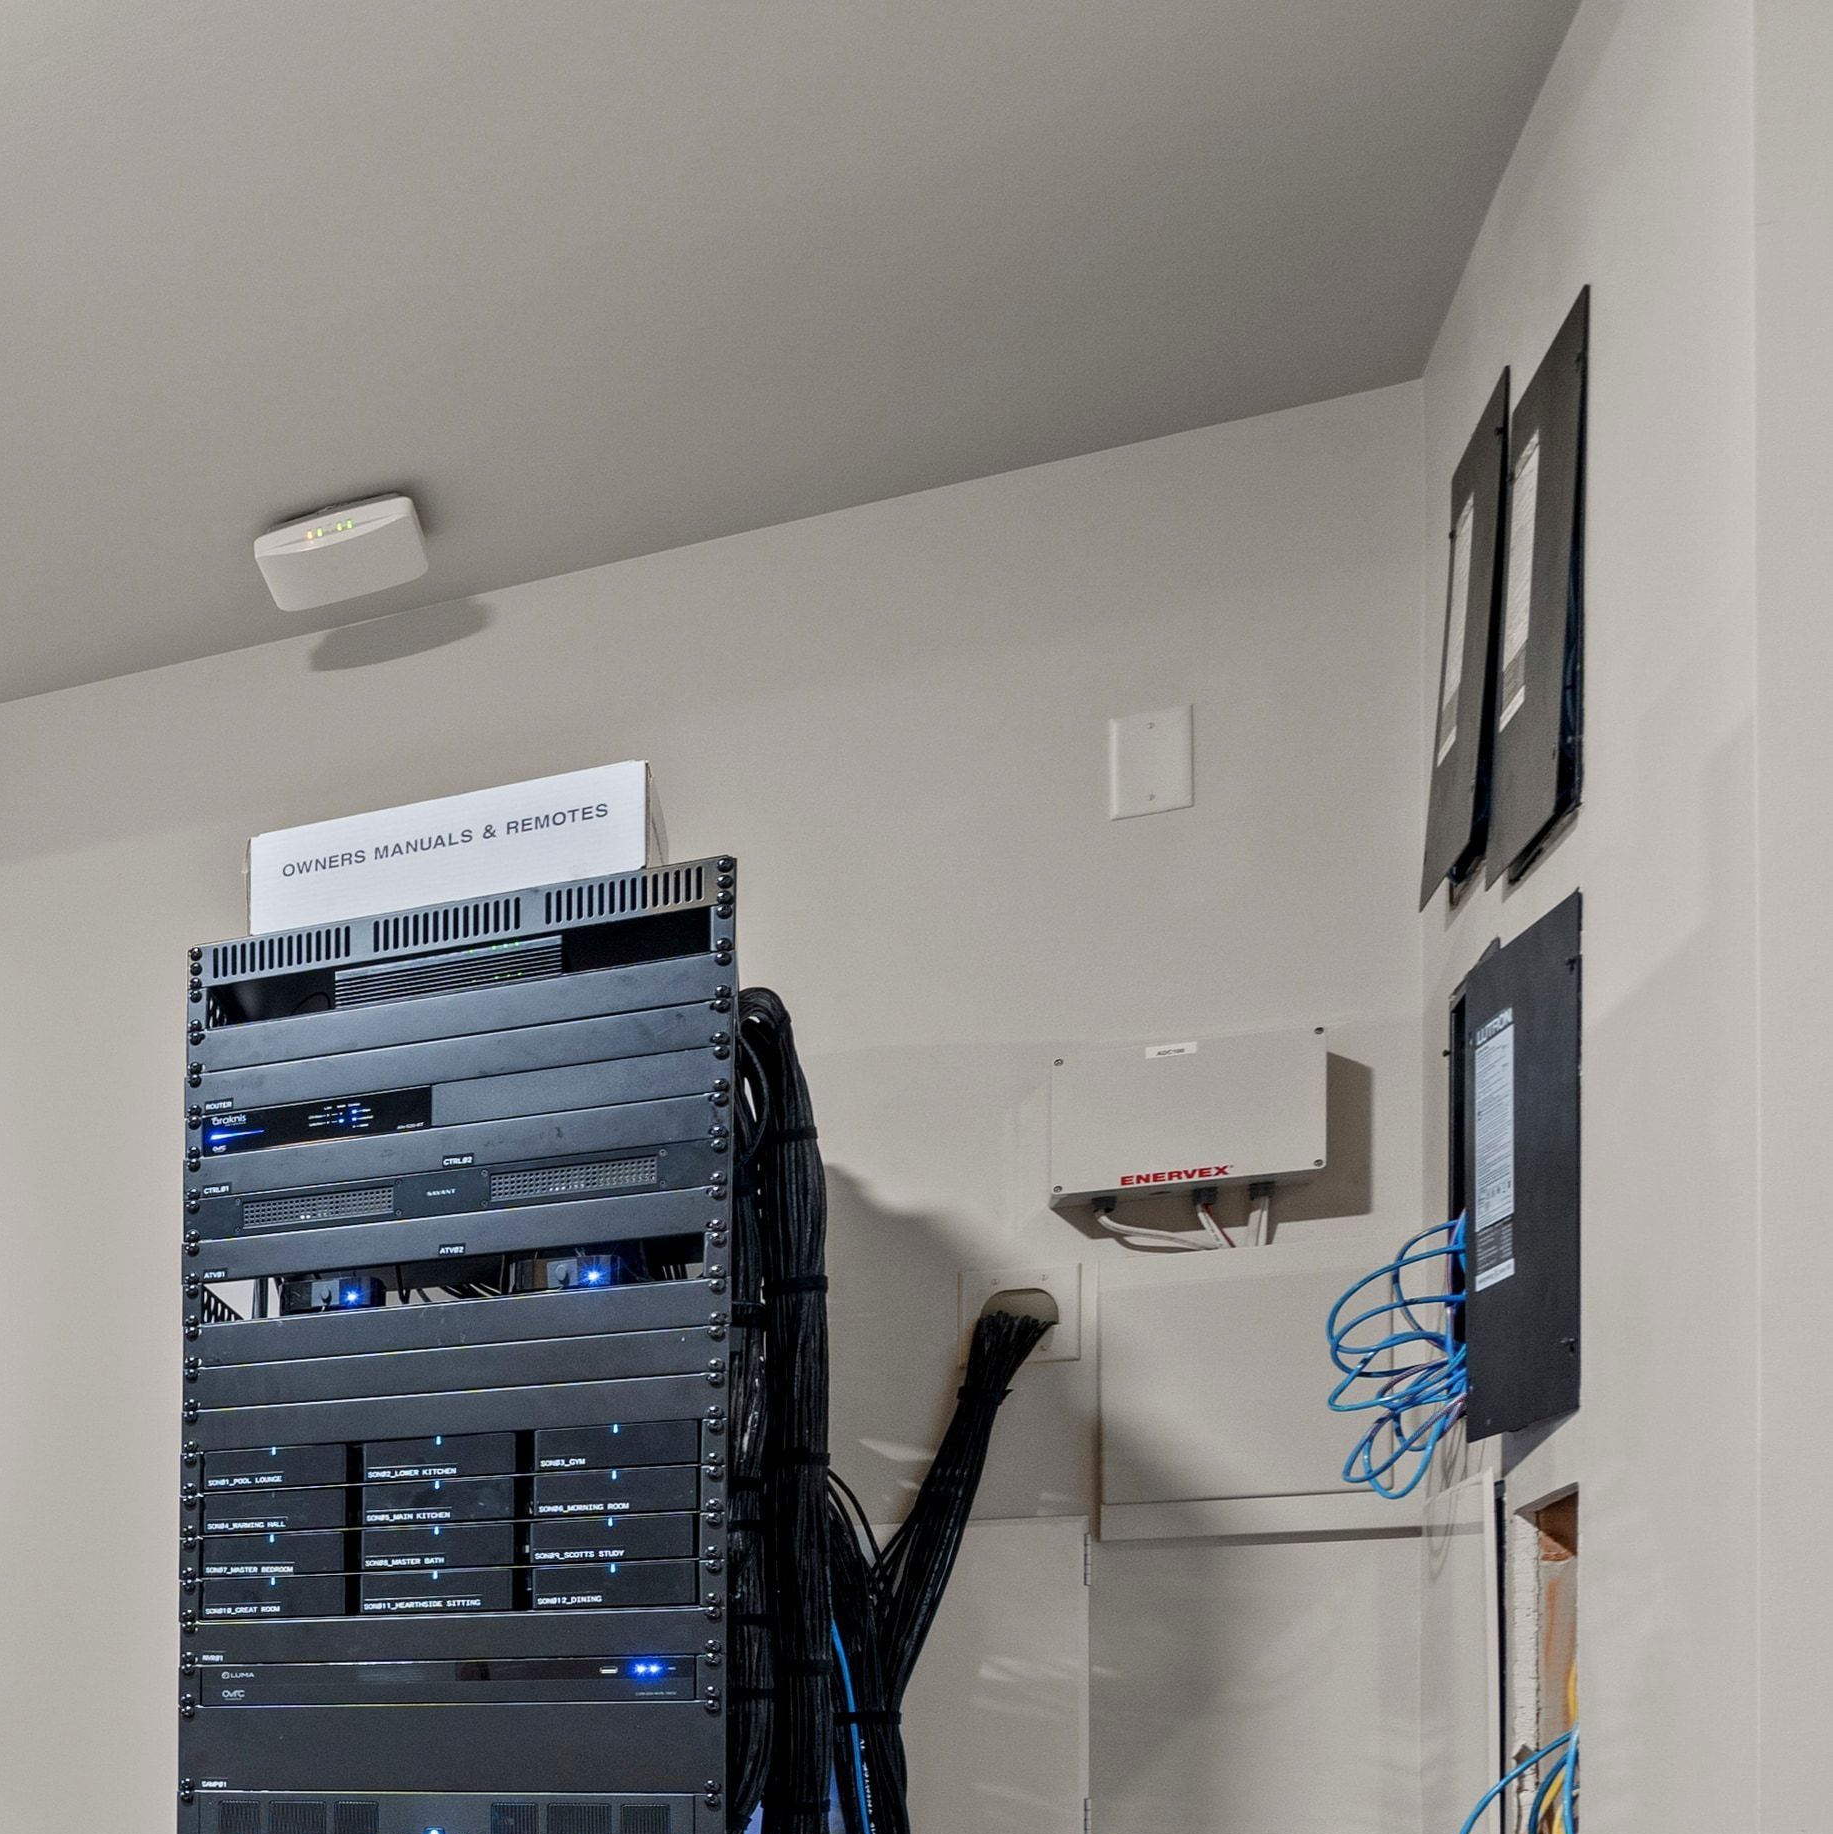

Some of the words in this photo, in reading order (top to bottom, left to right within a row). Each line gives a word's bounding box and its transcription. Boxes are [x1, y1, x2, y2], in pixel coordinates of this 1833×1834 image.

[282, 849, 366, 878] OWNERS
[373, 828, 473, 862] MANUALS
[482, 824, 497, 840] &
[506, 802, 609, 836] REMOTES
[205, 1101, 233, 1111] ROUTER
[1120, 1165, 1230, 1186] ENERVEX
[439, 1246, 464, 1255] ATV02
[203, 1271, 225, 1279] ATV01
[422, 1467, 457, 1476] KITCHEN
[607, 1502, 630, 1510] ROOM
[416, 1511, 451, 1520] KITCHEN
[598, 1549, 625, 1557] STUDY
[446, 1599, 482, 1607] SITTING
